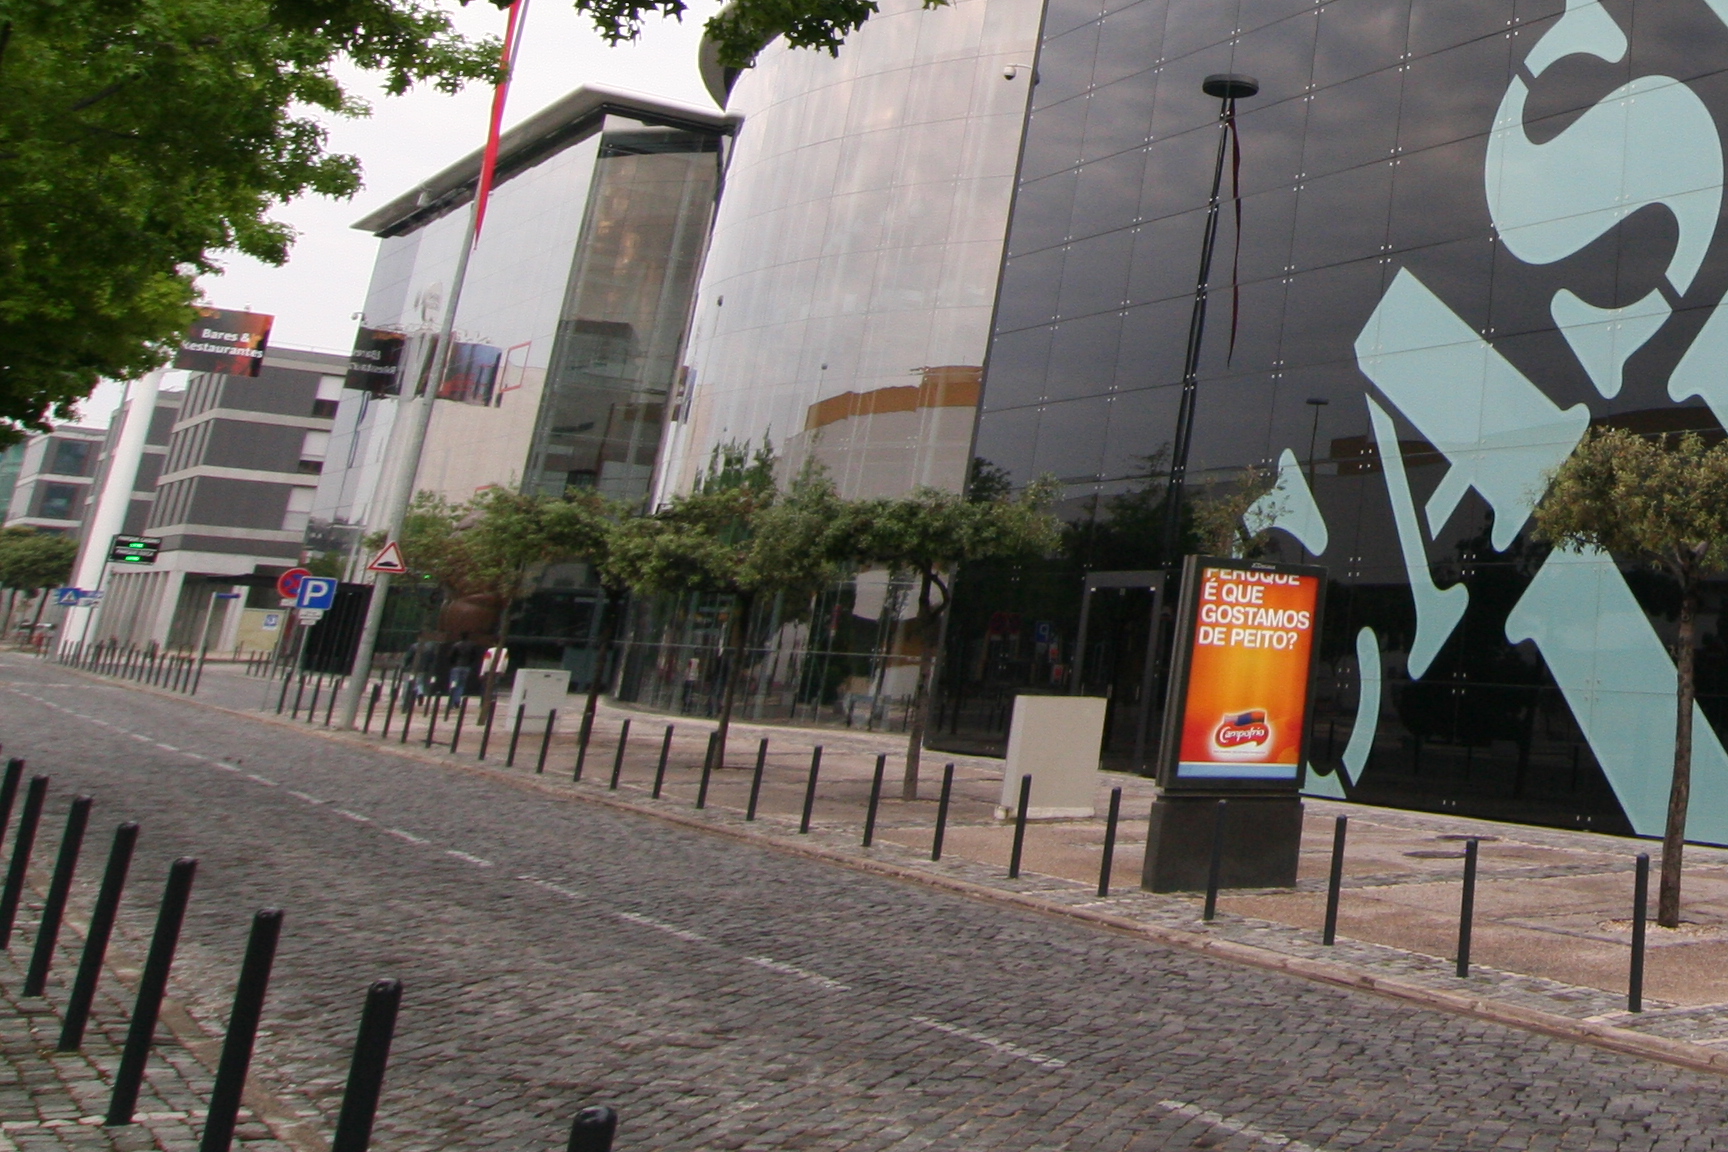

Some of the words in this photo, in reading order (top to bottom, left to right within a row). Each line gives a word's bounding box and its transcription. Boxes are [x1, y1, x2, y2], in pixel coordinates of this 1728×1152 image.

[202, 328, 239, 341] Bares
[240, 332, 250, 343] &
[302, 580, 329, 606] P
[1204, 577, 1218, 600] É
[1222, 583, 1265, 604] QUE
[1202, 603, 1310, 629] GOSTAMOS
[1198, 626, 1227, 646] DE
[1230, 628, 1298, 650] PEITO?
